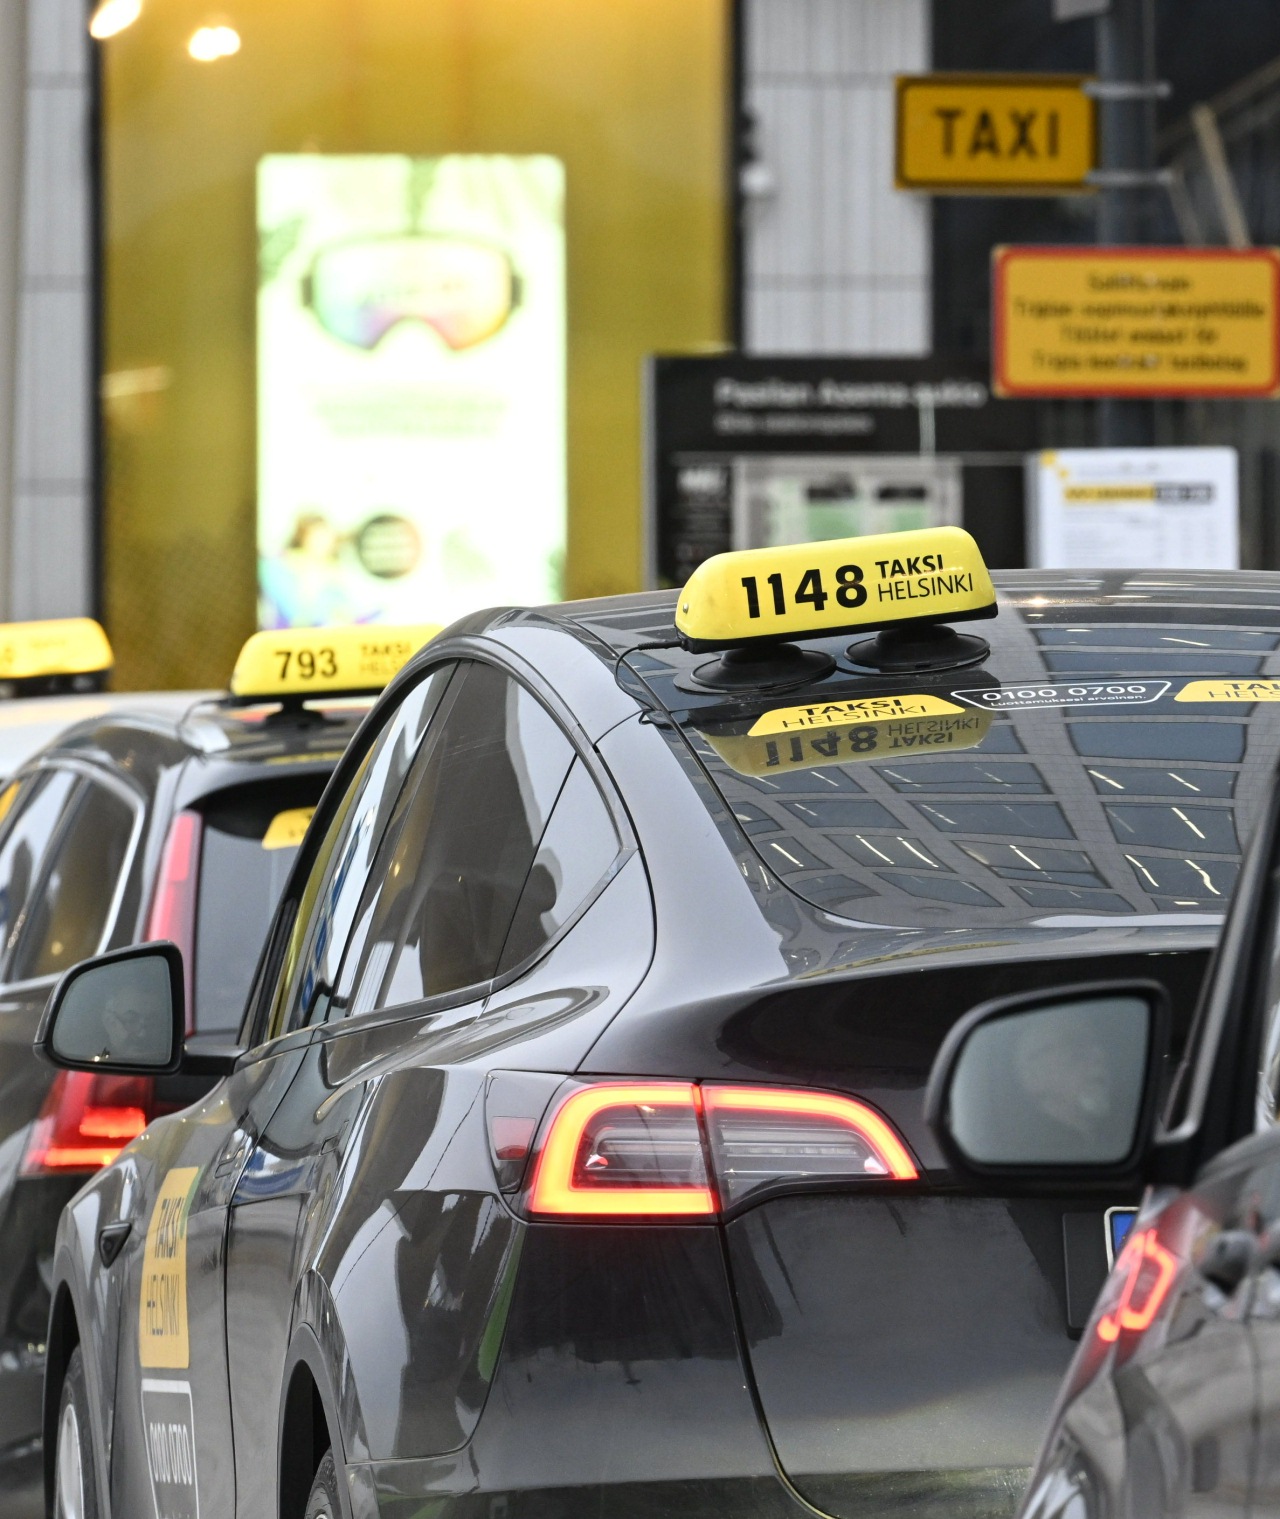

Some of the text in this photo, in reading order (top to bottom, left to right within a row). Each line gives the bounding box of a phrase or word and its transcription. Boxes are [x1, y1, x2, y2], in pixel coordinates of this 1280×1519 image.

[933, 108, 1061, 158] TAXI
[875, 554, 944, 579] TAKSI
[741, 564, 868, 618] 1148
[878, 573, 973, 602] HELSINKI
[275, 646, 338, 680] 793
[360, 641, 411, 656] TAKSI
[798, 699, 903, 716] TAKSI
[982, 685, 1146, 701] 0100 0700
[991, 696, 1084, 707] Luottamuksesi
[782, 705, 927, 728] HELSINKI
[154, 1197, 183, 1258] TAKSI
[146, 1274, 180, 1336] HELSINKI
[150, 1422, 192, 1486] 0100 0700
